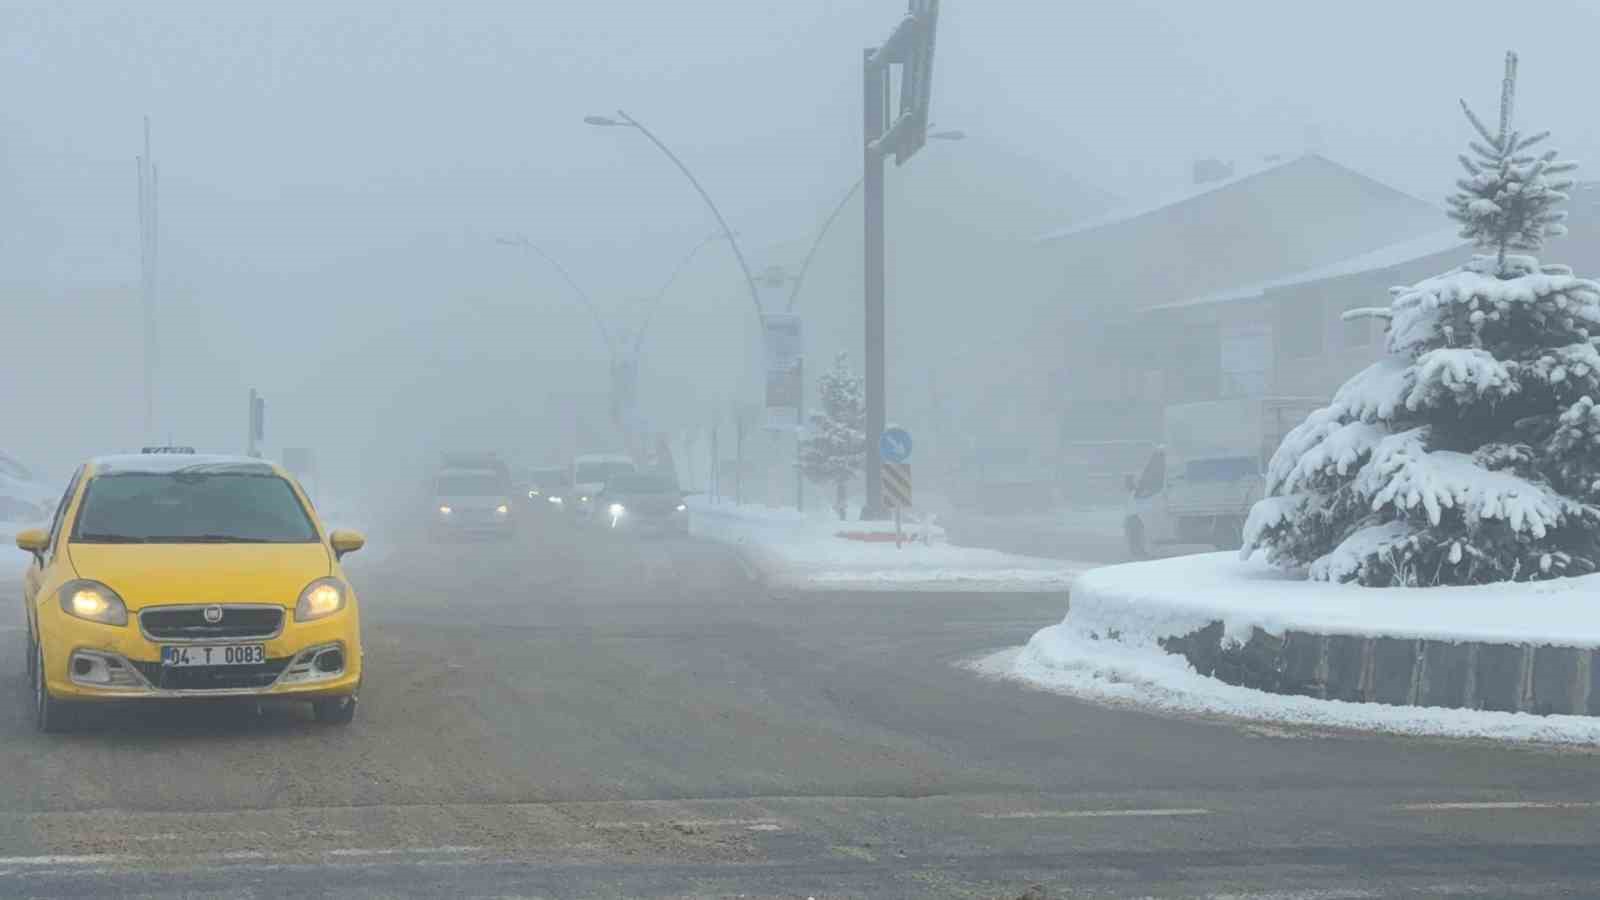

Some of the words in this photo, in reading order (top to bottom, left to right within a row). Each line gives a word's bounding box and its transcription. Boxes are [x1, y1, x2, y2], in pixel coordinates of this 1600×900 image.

[172, 647, 190, 665] 04
[203, 647, 213, 665] T
[225, 646, 263, 664] 0083
